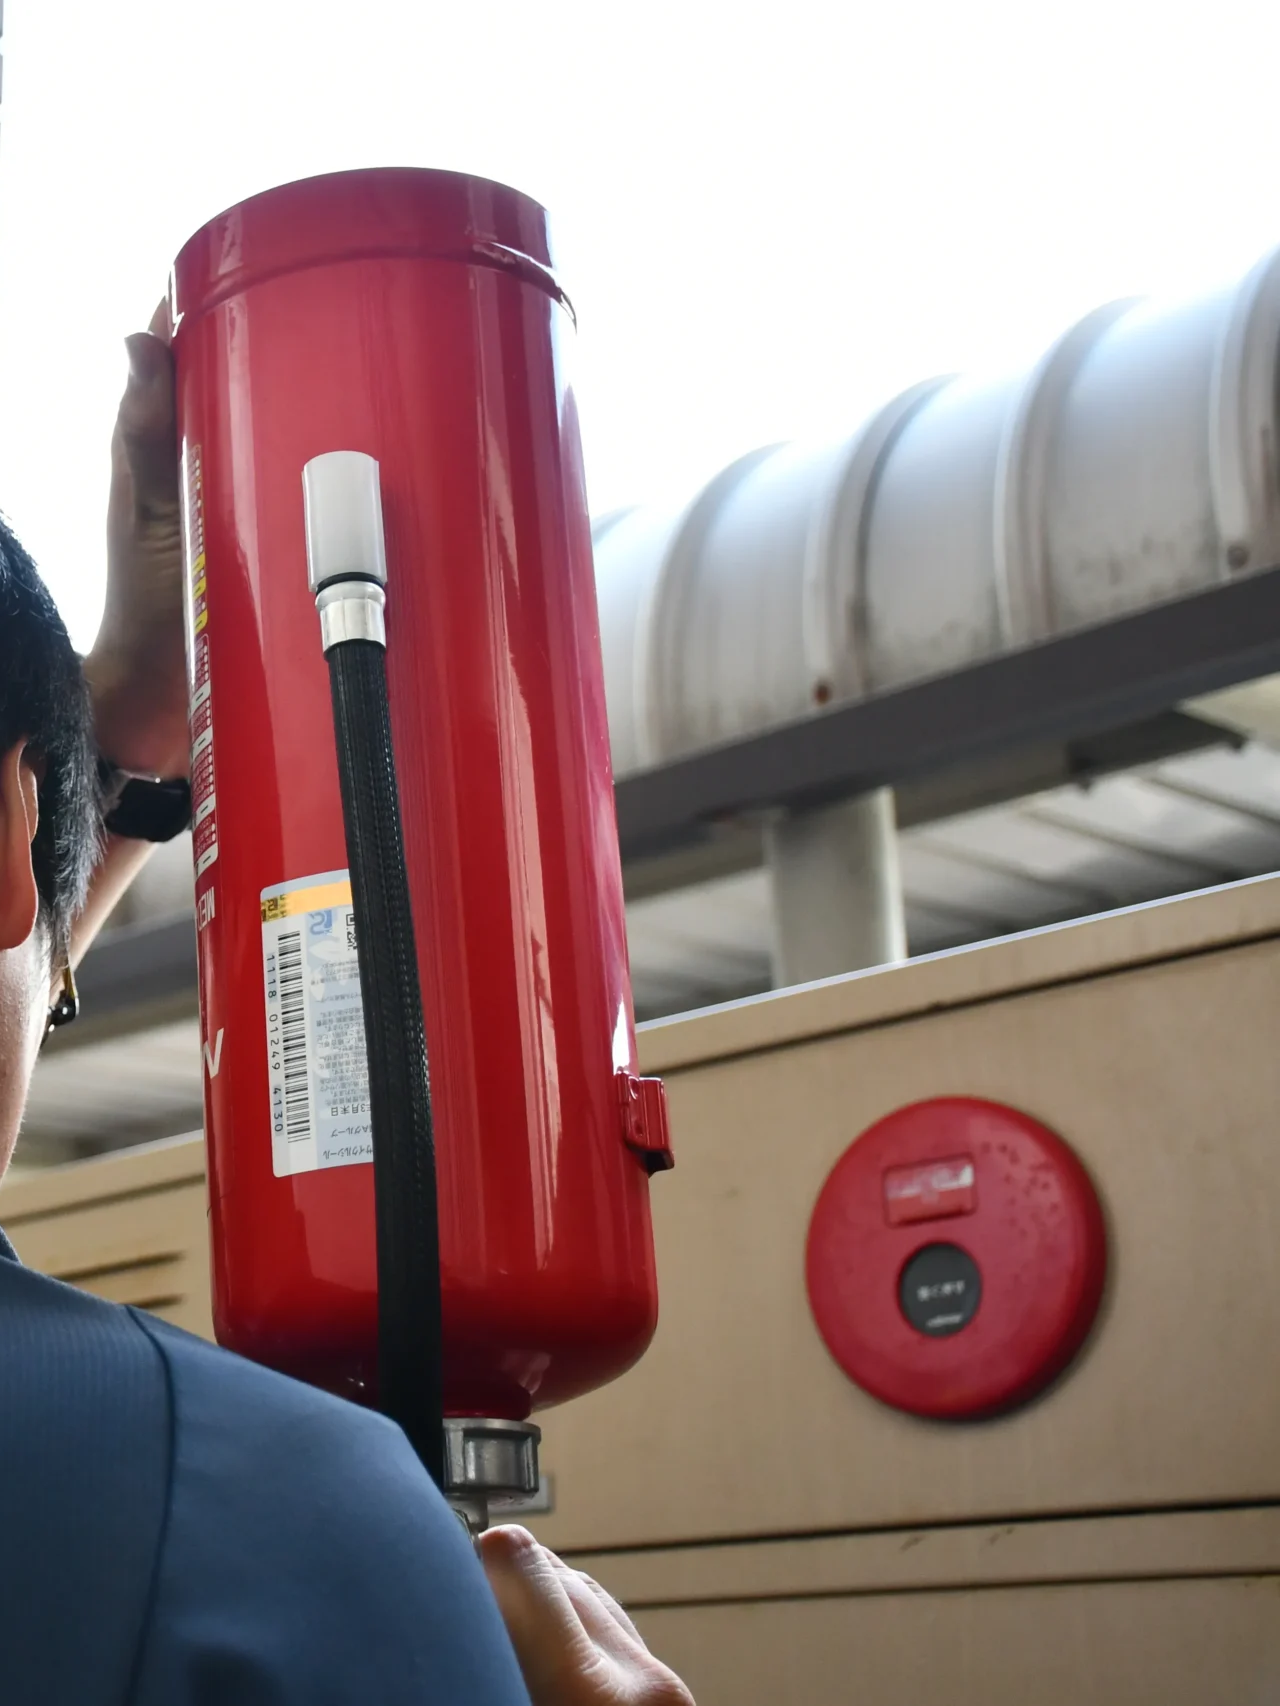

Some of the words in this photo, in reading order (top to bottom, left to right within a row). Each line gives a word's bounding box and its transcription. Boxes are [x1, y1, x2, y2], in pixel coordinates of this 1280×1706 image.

[266, 954, 277, 999] 1118
[269, 1014, 281, 1071] 01249
[272, 1087, 284, 1132] 4130
